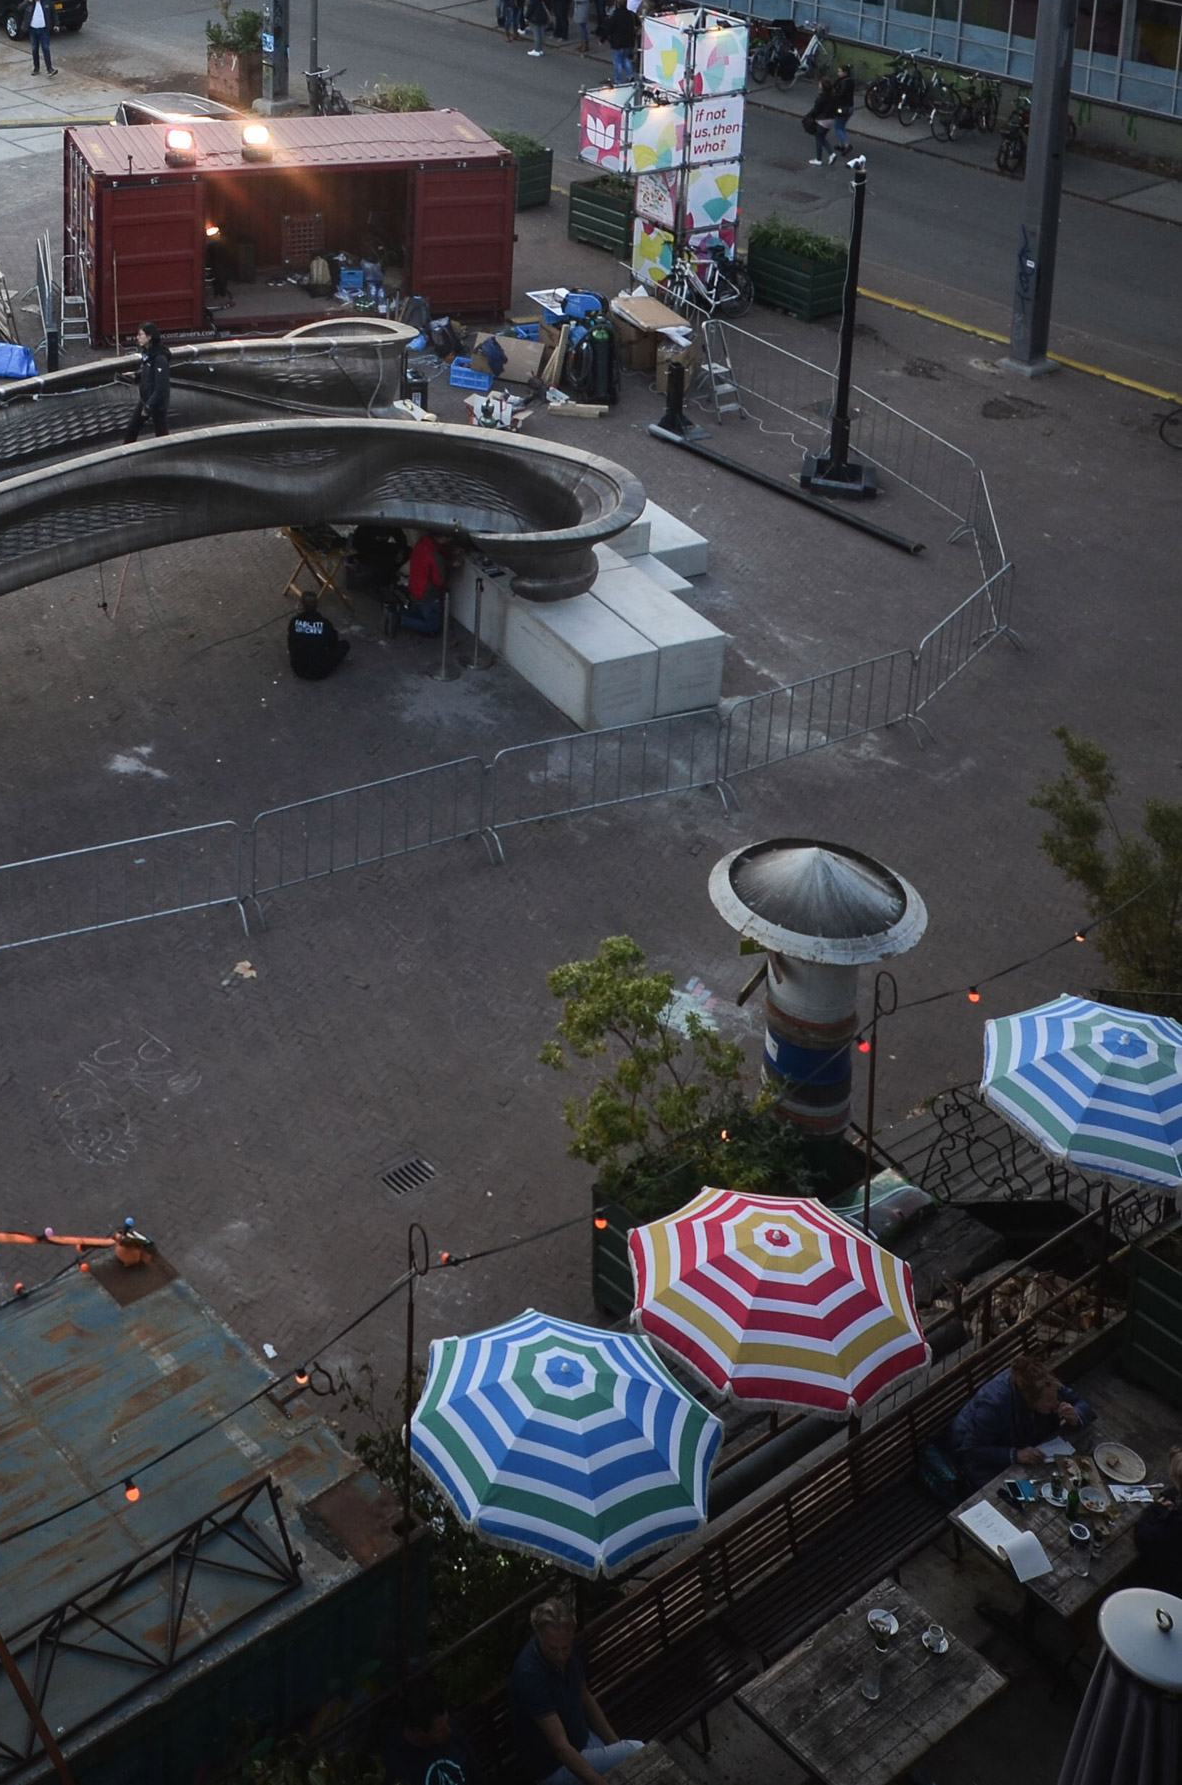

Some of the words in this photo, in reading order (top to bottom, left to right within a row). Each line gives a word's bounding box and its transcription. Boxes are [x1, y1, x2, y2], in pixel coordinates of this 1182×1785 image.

[695, 109, 704, 122] if
[706, 108, 727, 121] not
[713, 123, 740, 136] then
[694, 139, 726, 154] who?
